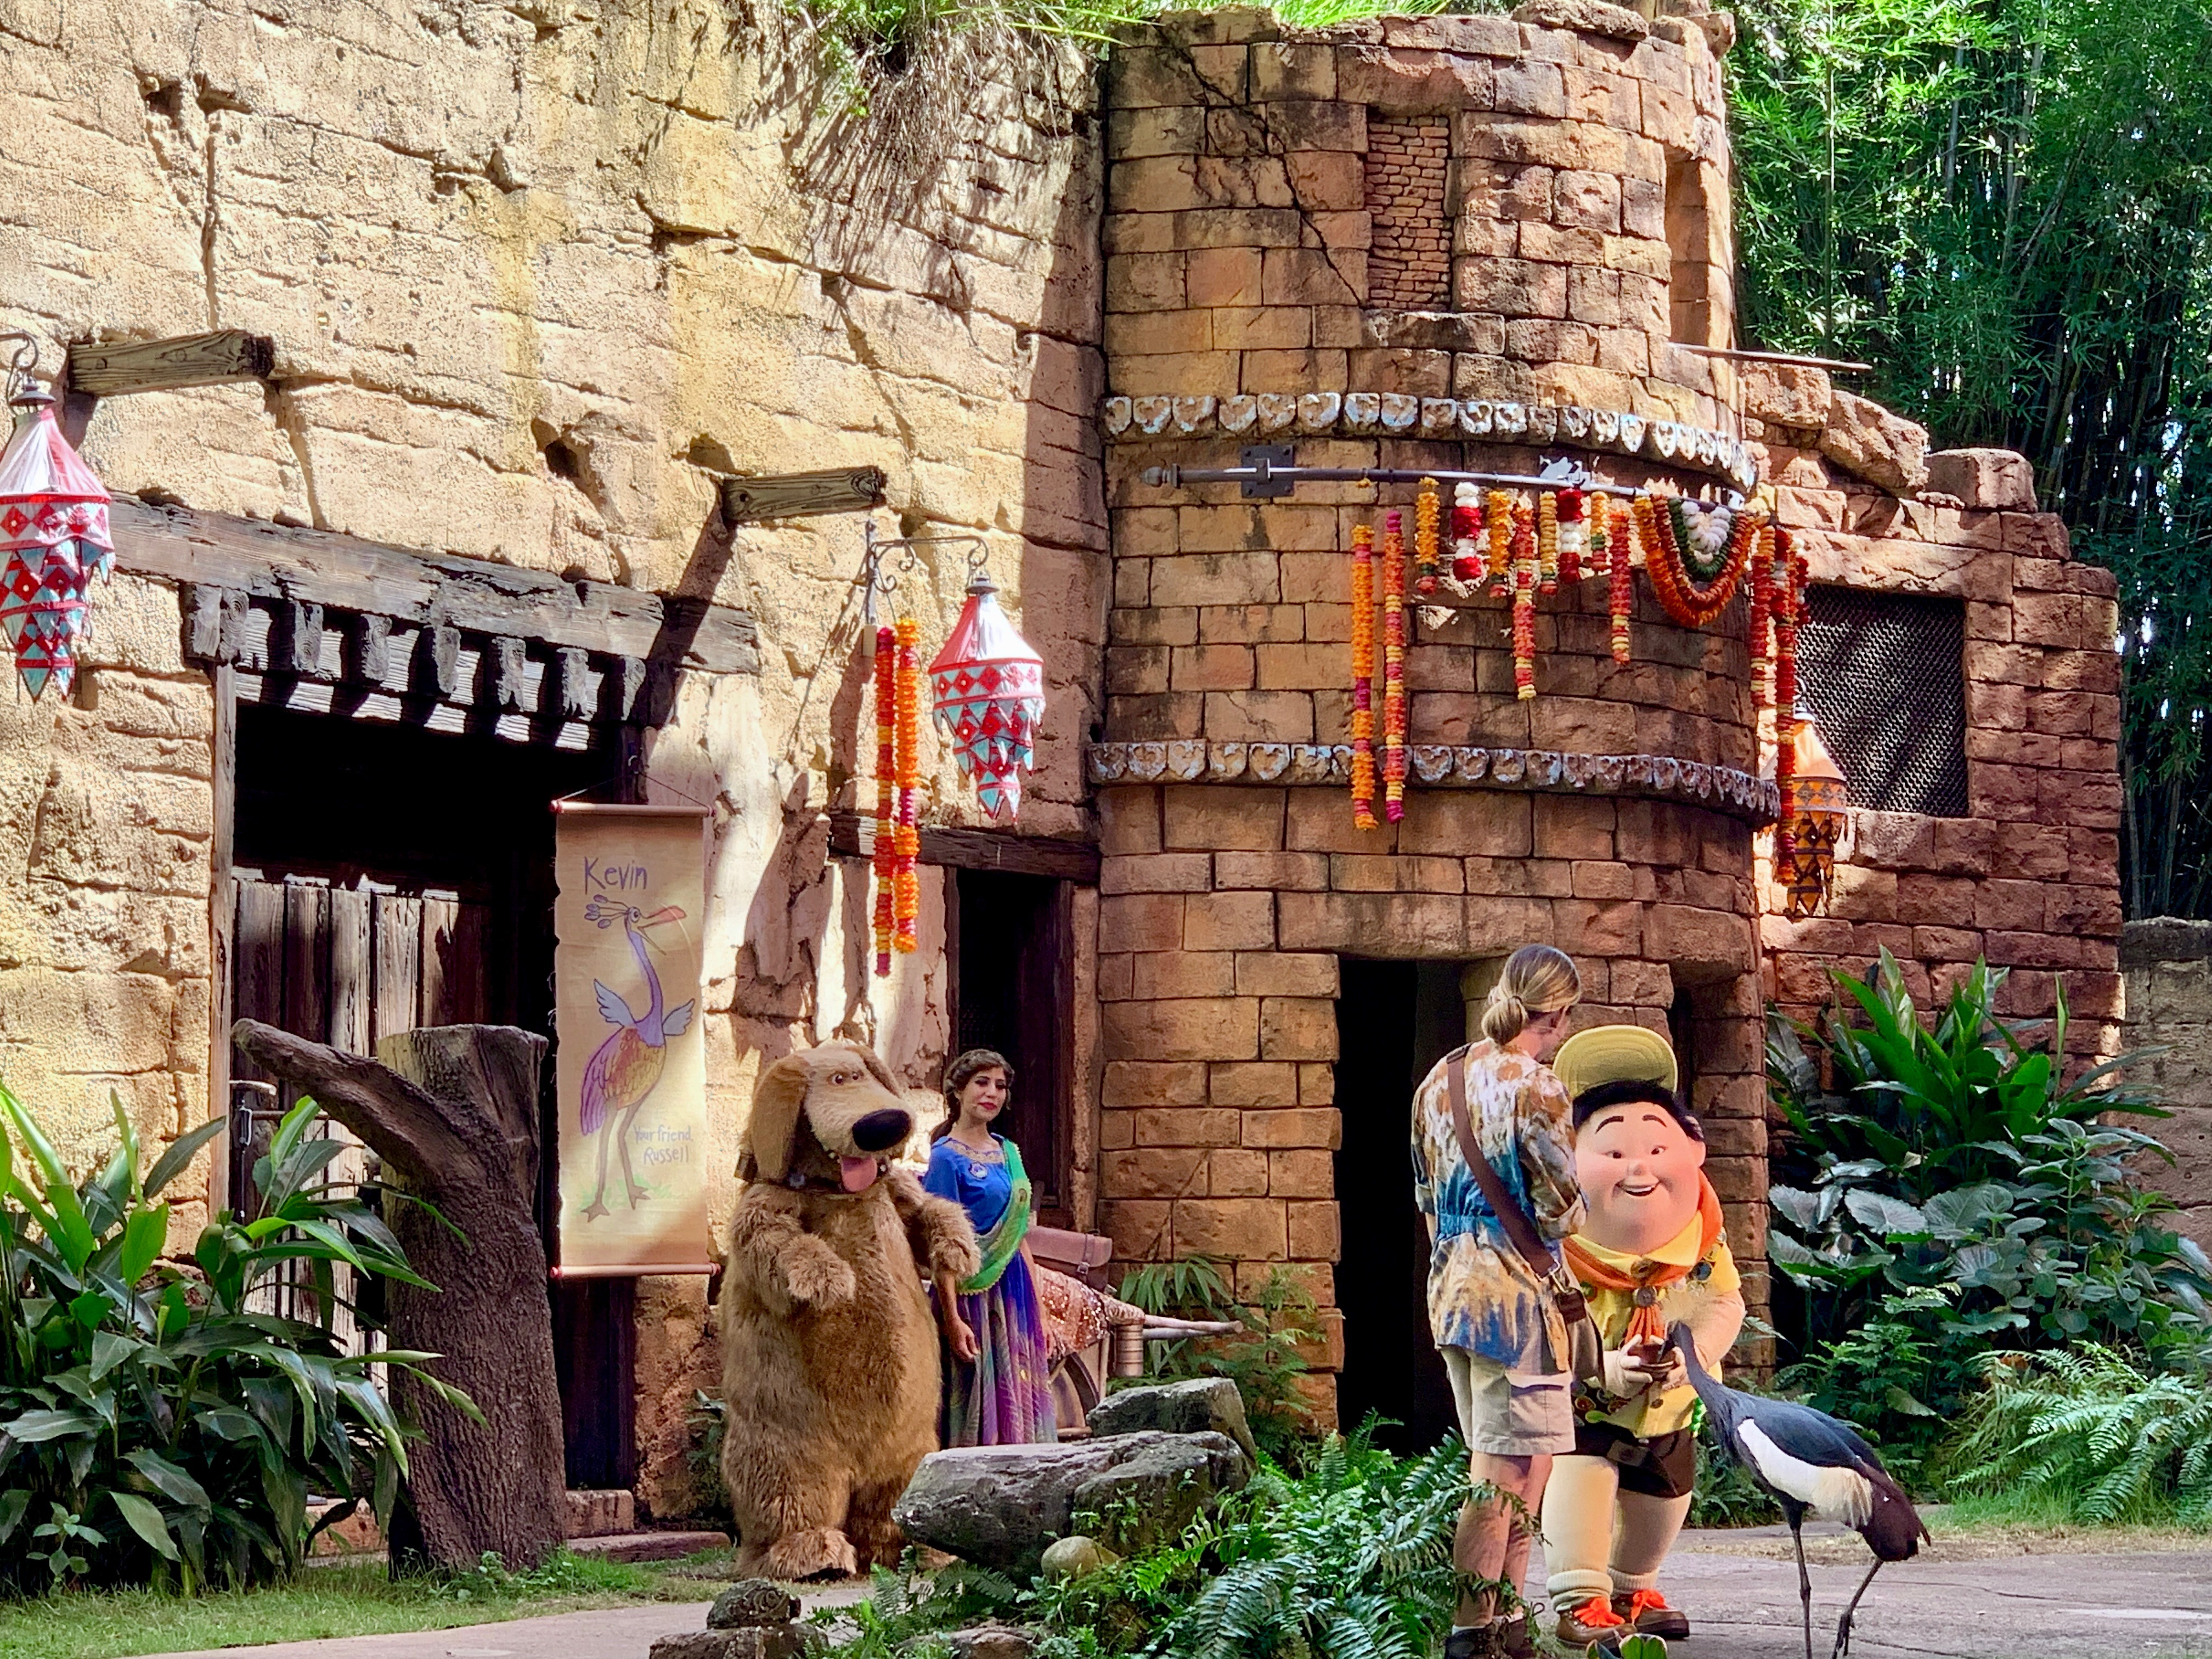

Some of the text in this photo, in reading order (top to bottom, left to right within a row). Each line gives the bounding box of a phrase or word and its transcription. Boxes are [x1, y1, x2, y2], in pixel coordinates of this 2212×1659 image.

[584, 856, 647, 895] Kevin
[633, 1124, 655, 1144] Your
[644, 1146, 689, 1166] Russell
